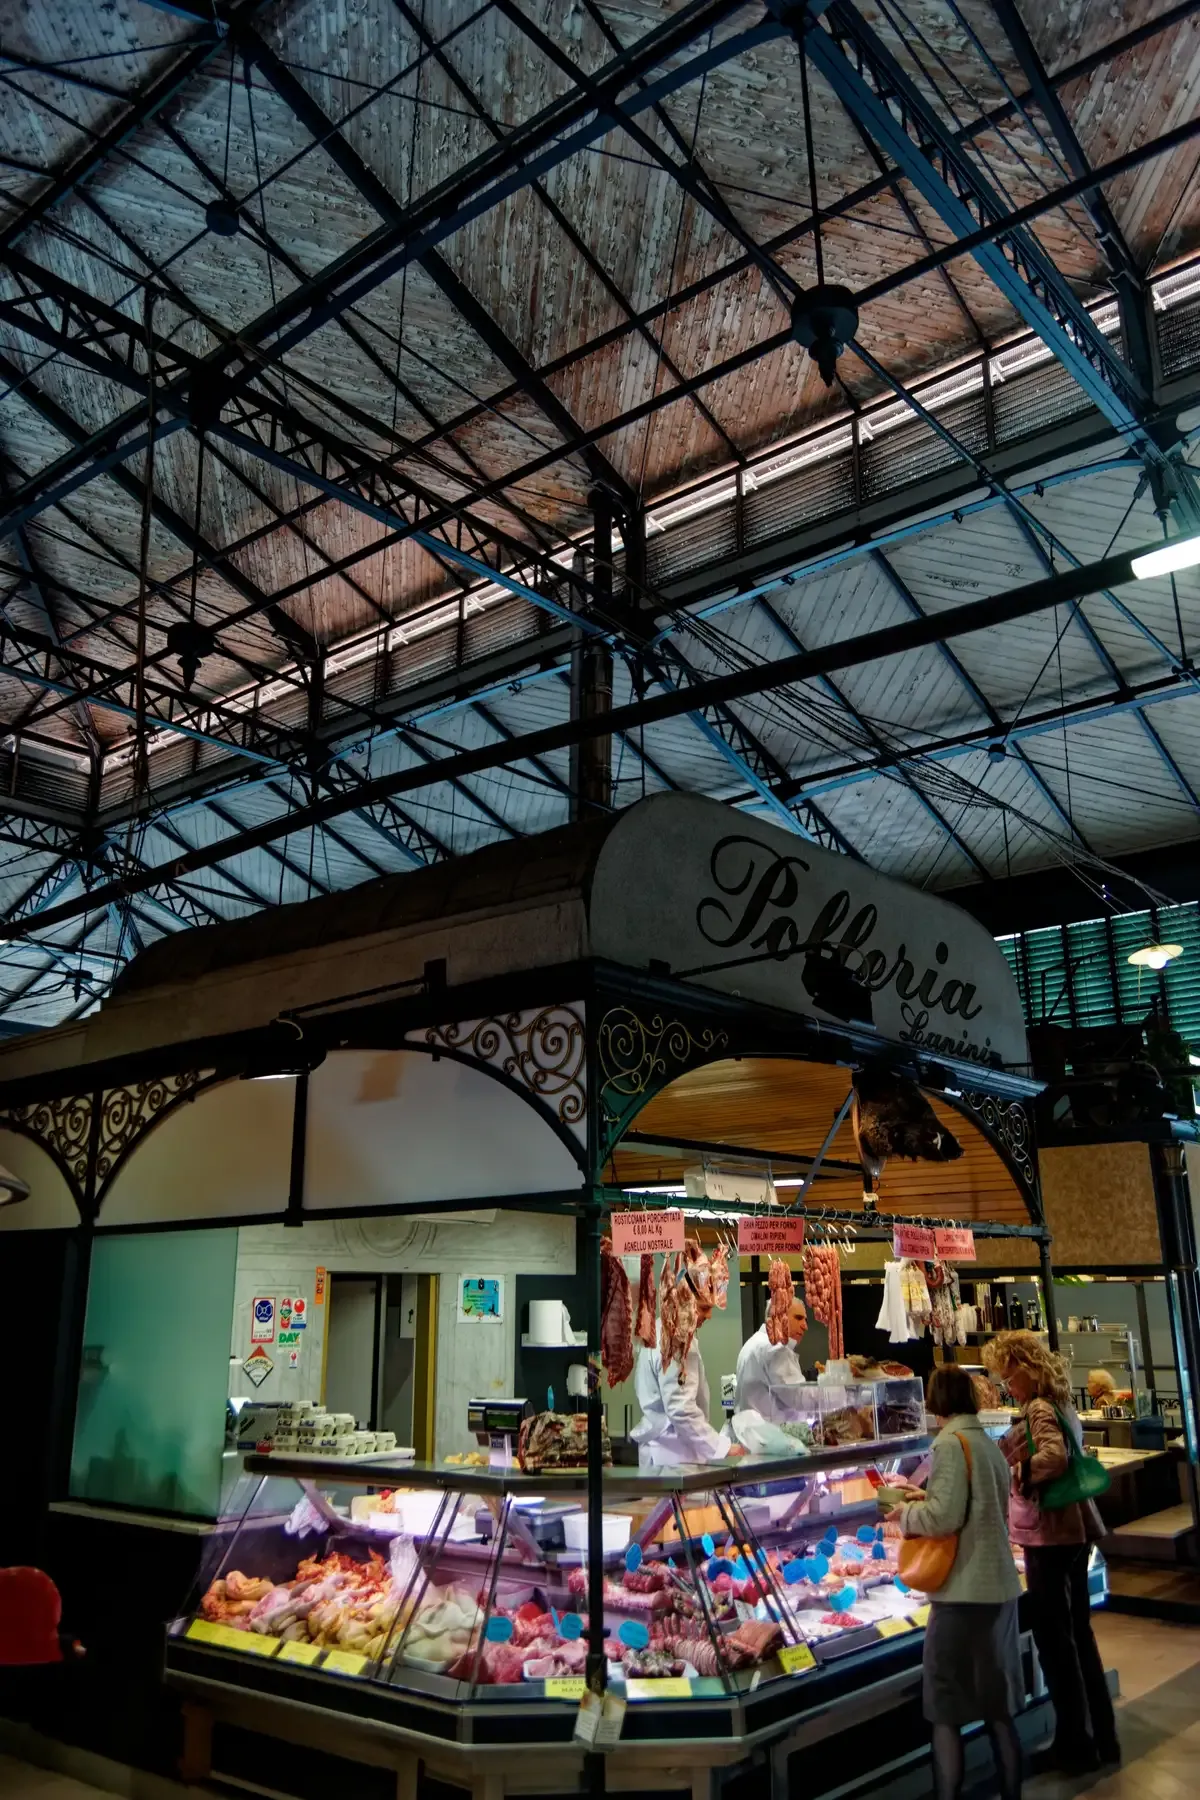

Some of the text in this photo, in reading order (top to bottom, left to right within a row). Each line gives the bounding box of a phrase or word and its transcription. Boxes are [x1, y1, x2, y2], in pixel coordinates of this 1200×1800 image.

[696, 835, 982, 1020] Polleria
[648, 1225, 654, 1234] AL
[655, 1224, 662, 1236] Kg
[755, 1221, 768, 1230] PEZZO
[770, 1221, 779, 1230] PER
[780, 1221, 797, 1230] FORNO
[624, 1239, 673, 1252] AGNELLO NOSTRALE
[761, 1243, 774, 1252] LATTE
[775, 1243, 784, 1252] PER
[785, 1242, 801, 1252] FORNO
[278, 1332, 300, 1344] DAY
